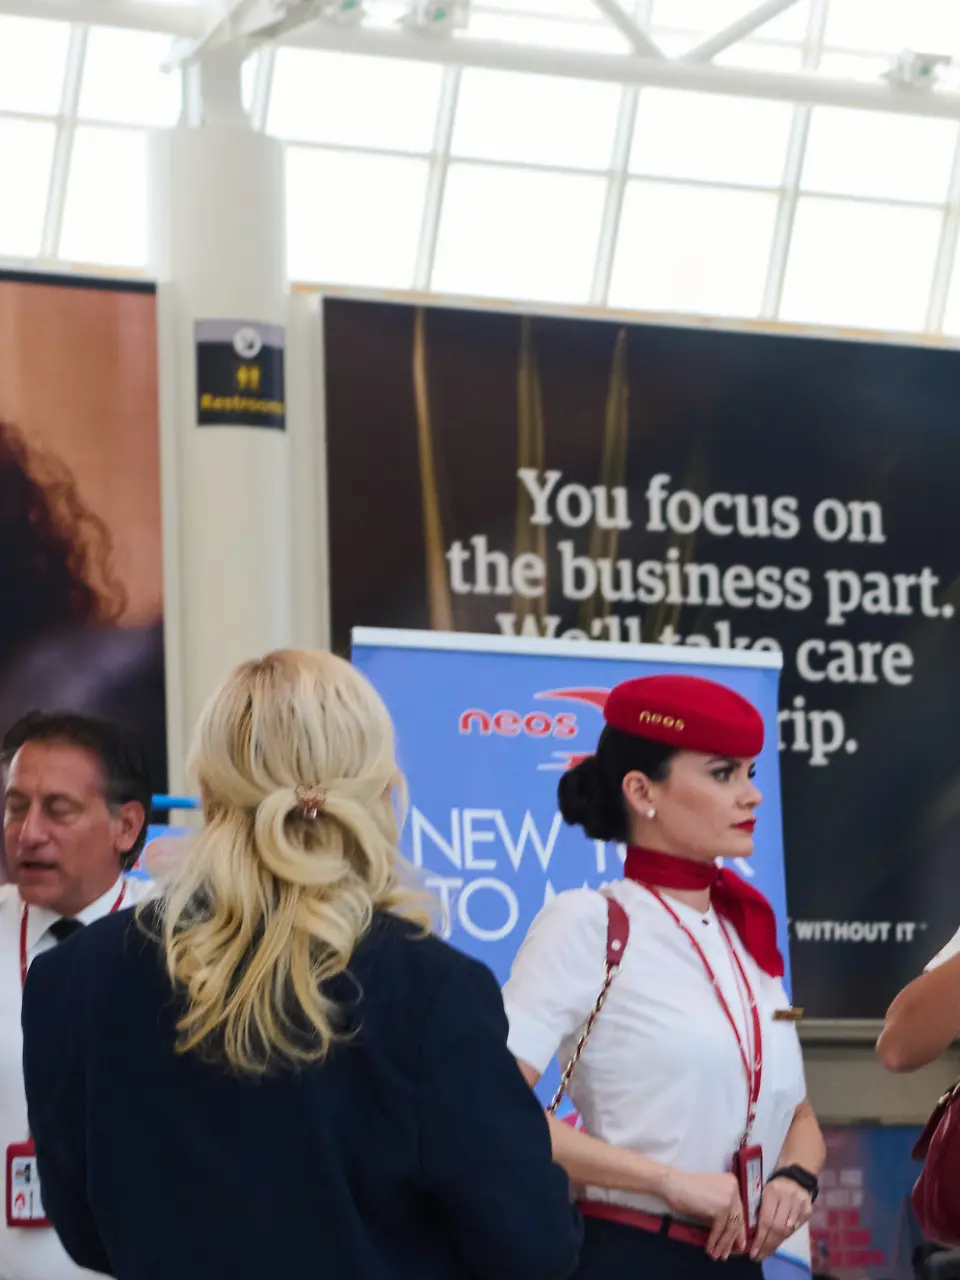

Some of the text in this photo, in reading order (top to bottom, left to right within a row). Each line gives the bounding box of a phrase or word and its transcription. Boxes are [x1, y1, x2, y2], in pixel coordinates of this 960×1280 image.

[517, 466, 886, 544] You focus on
[446, 535, 955, 626] the business part.
[795, 638, 914, 685] care
[459, 708, 578, 740] neos
[638, 709, 685, 733] neos
[776, 693, 858, 767] rip.
[411, 805, 563, 873] NEW
[424, 876, 519, 942] TO
[795, 920, 916, 943] WITHOUT IT
